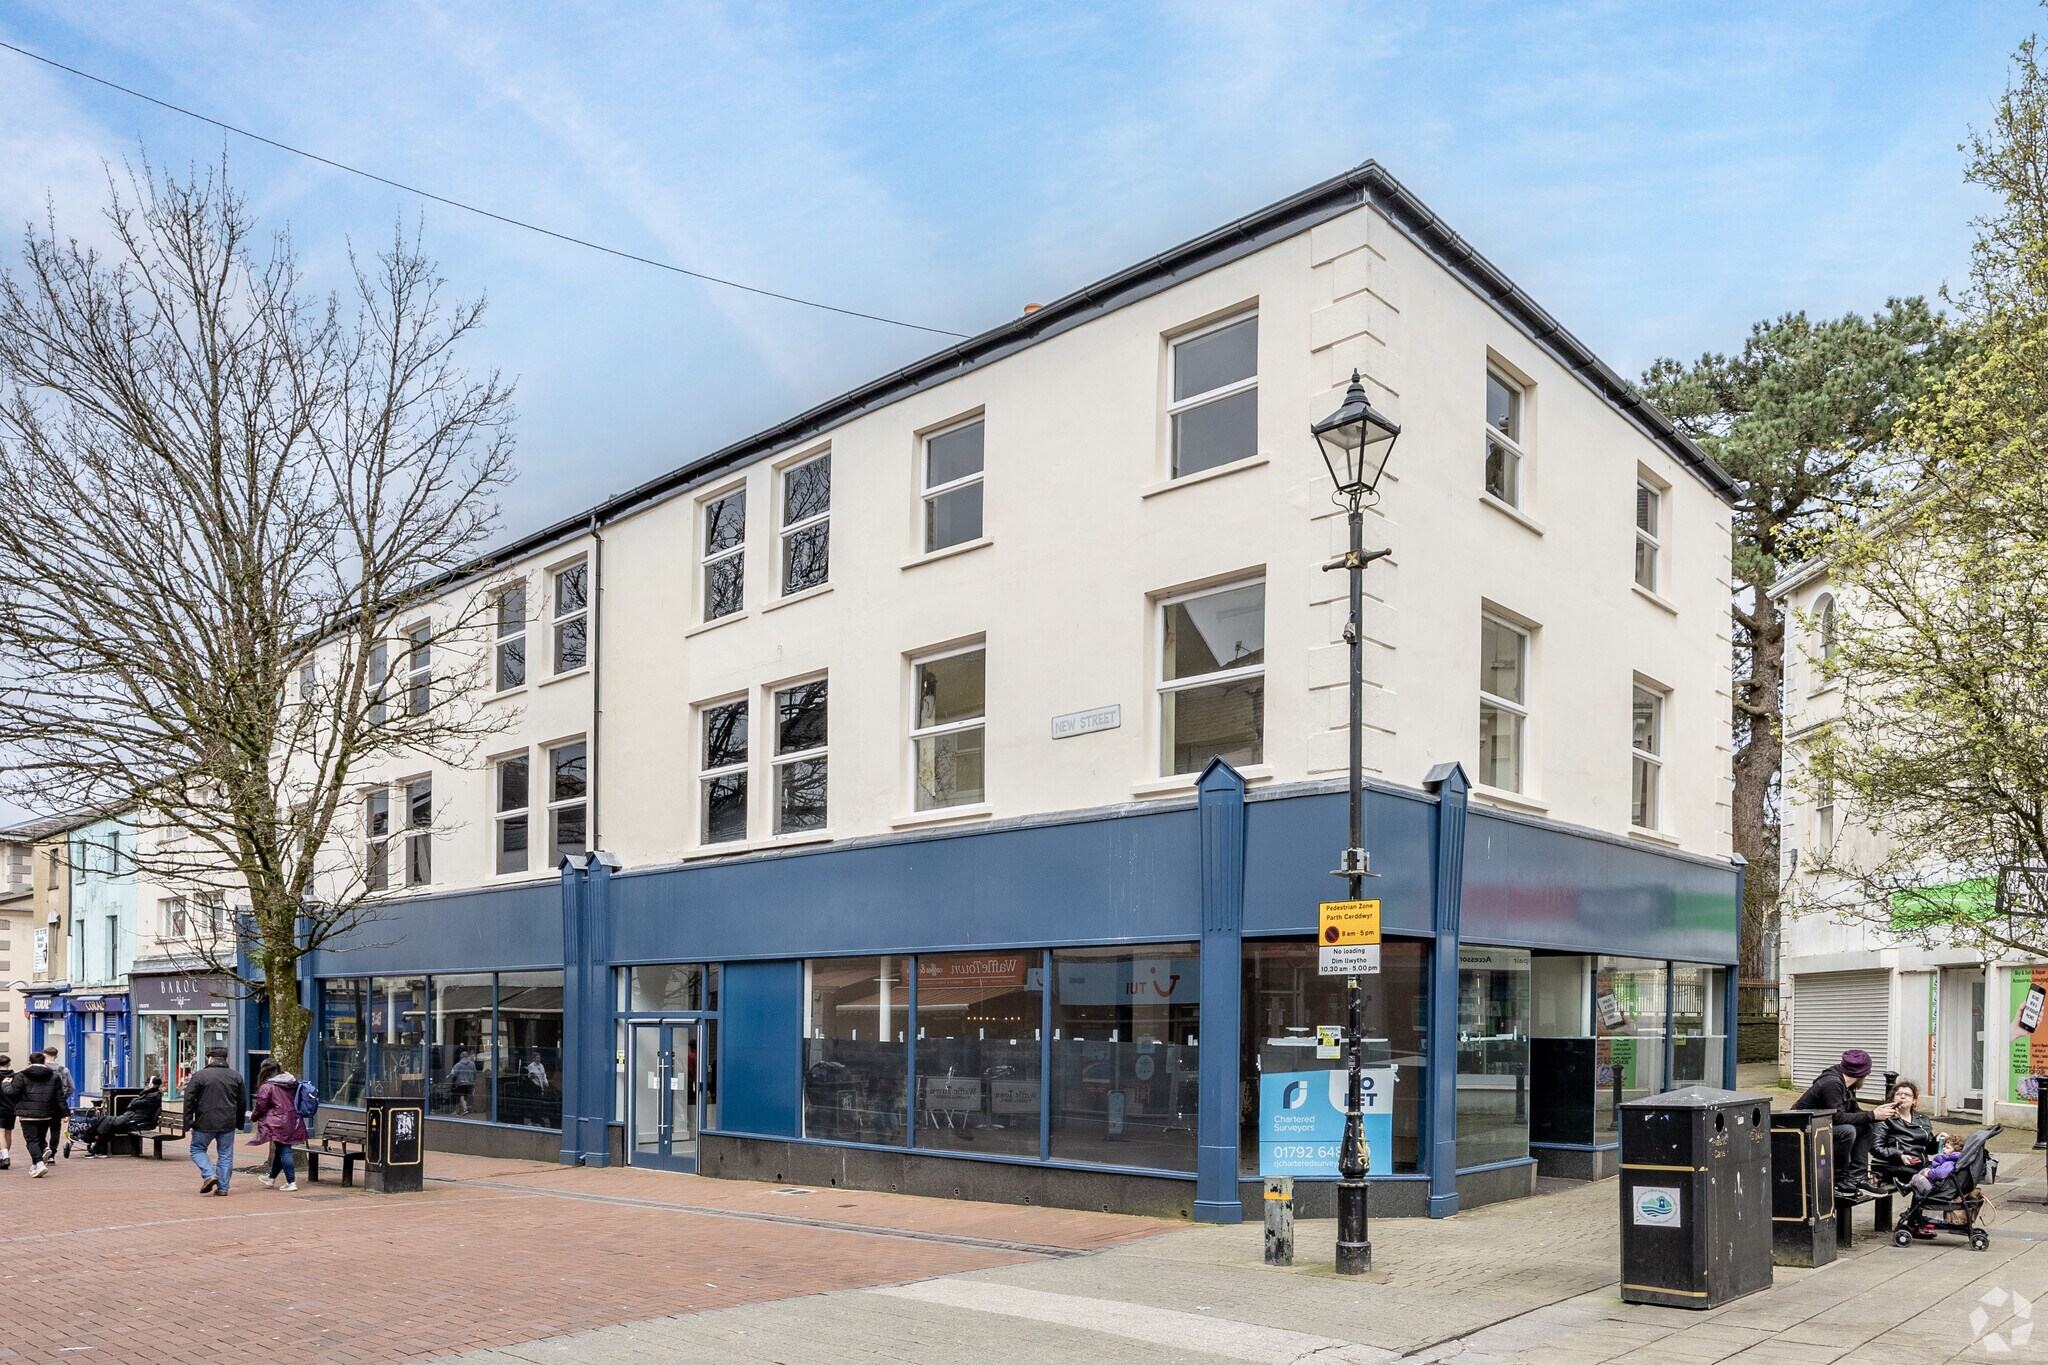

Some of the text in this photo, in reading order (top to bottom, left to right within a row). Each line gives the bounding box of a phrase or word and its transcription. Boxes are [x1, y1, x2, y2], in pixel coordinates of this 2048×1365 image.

[1055, 710, 1116, 734] NEW STREET
[34, 999, 50, 1010] CORAL
[85, 1001, 105, 1011] CORAL
[1273, 1115, 1315, 1123] Chartered
[1273, 1123, 1315, 1132] Surveyors
[1273, 1146, 1314, 1158] 01792
